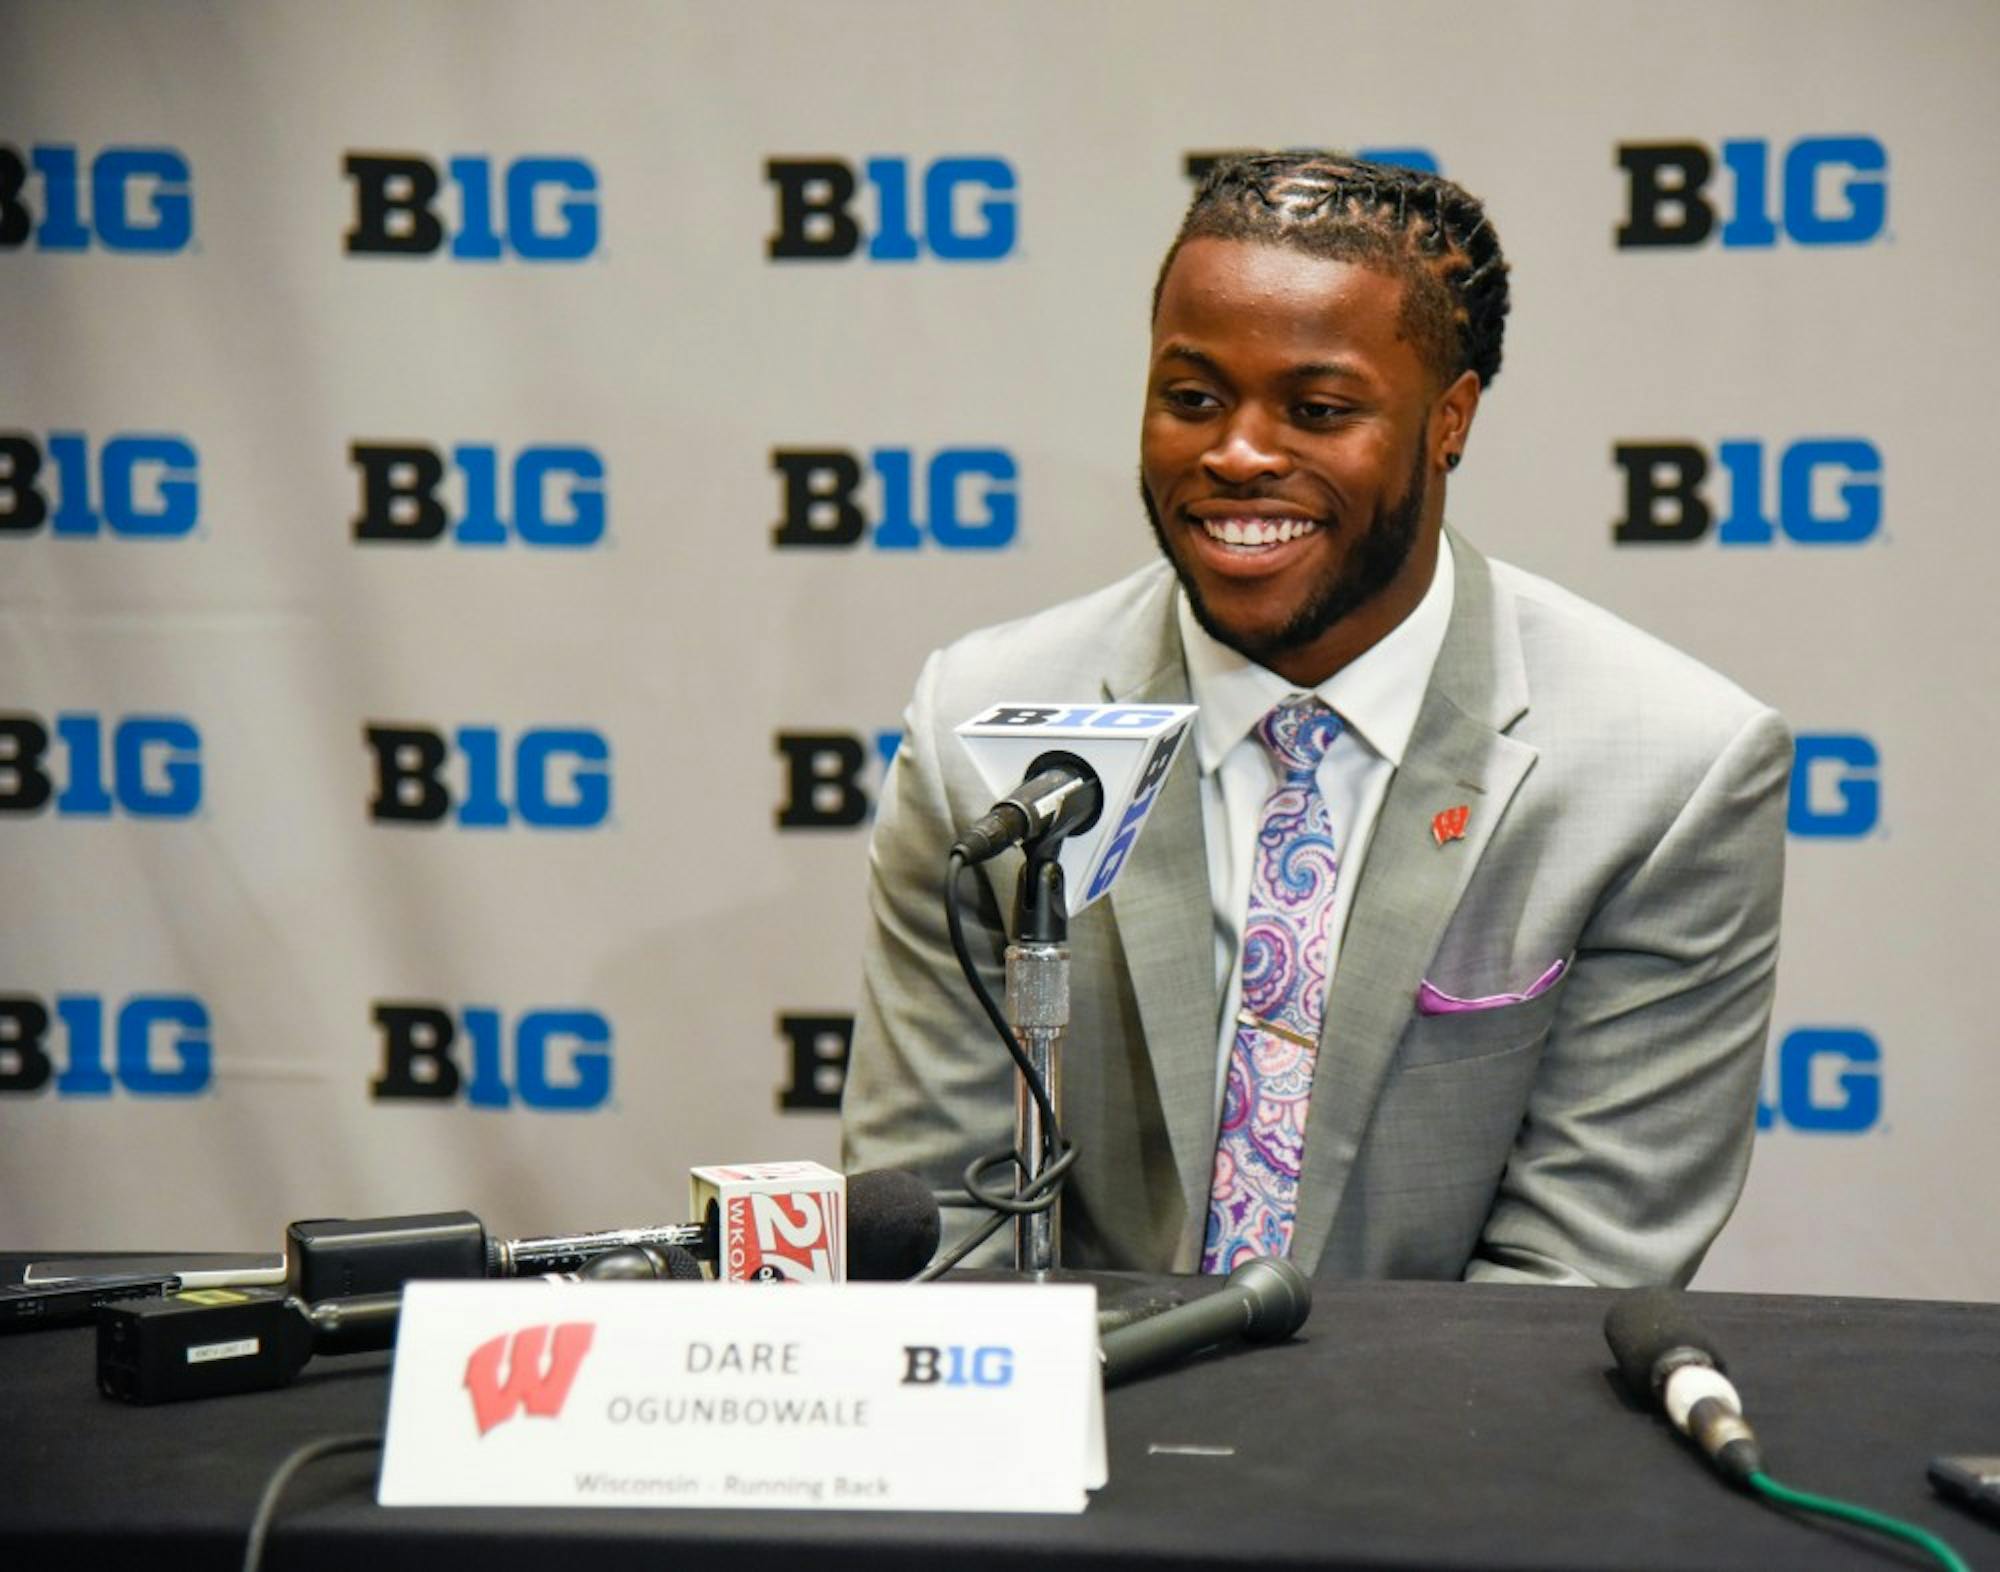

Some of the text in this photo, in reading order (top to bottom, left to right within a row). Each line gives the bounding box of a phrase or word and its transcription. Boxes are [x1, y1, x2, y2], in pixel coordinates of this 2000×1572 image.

[342, 152, 600, 261] B1G
[764, 156, 1018, 261] B1G
[1615, 136, 1888, 249] B1G
[350, 442, 606, 549] B1G
[770, 448, 1018, 550] B1G
[1612, 438, 1883, 546] B1G
[363, 722, 611, 829] B1G
[369, 1002, 613, 1111] B1G
[685, 1342, 801, 1375] DARE
[900, 1344, 1014, 1388] B1G
[606, 1396, 869, 1428] OGUNBOWALE
[574, 1473, 699, 1494] Wisconsin
[724, 1474, 825, 1500] Running
[833, 1476, 890, 1496] Back
